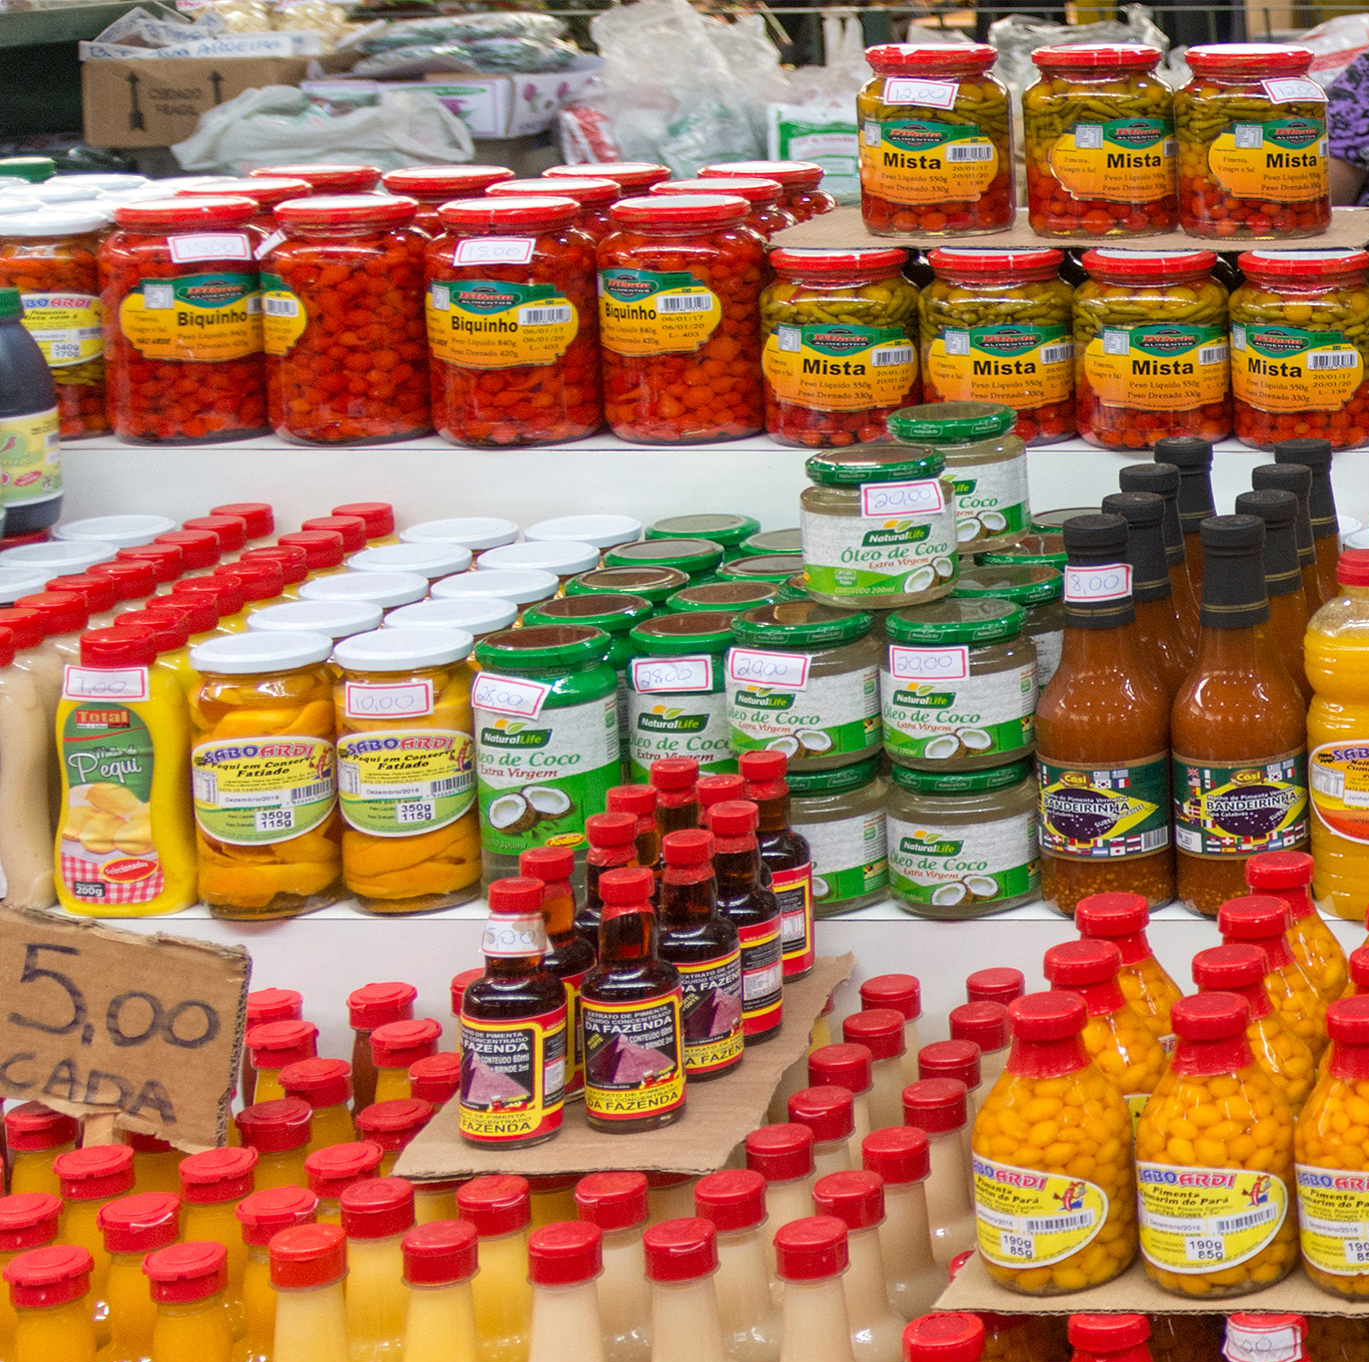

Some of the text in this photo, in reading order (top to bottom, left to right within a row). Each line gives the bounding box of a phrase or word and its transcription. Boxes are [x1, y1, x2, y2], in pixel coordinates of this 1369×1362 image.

[883, 153, 941, 170] Mista
[1107, 153, 1161, 168] Mista
[1266, 154, 1317, 167] Mista
[177, 310, 247, 327] Biquinho
[605, 303, 657, 320] Biquinho
[452, 315, 517, 333] Biquinho
[802, 359, 866, 377] Mista
[973, 359, 1037, 376] Mista
[1132, 359, 1194, 377] Mista
[1249, 359, 1302, 378] Mista
[869, 529, 926, 544] NaturalLife
[841, 540, 948, 563] Óleo de Coco
[77, 710, 128, 724] Total
[760, 710, 821, 727] de Coco
[915, 710, 980, 725] de Coco
[481, 730, 542, 748] NaturalLife
[377, 759, 429, 771] Fatiado
[506, 751, 581, 766] de Coco
[68, 752, 141, 784] Pequi
[237, 766, 289, 778] Fatiado
[508, 766, 558, 781] Virgem
[401, 802, 431, 813] 350g
[1206, 793, 1296, 810] BANDEIRINHA
[260, 811, 292, 821] 350g
[401, 810, 432, 821] 115g
[260, 819, 292, 829] 115g
[903, 840, 955, 855] NaturalLife
[7, 944, 220, 1046] 5,00
[464, 1042, 529, 1053] FAZENDA
[3, 1059, 177, 1122] CADA
[588, 1092, 679, 1112] DA FAZENDA
[462, 1122, 531, 1133] FAZENDA
[1153, 1187, 1200, 1200] Pimenta
[1191, 1195, 1229, 1206] do Pará
[1189, 1240, 1223, 1253] 190g
[1198, 1250, 1223, 1260] 85g
